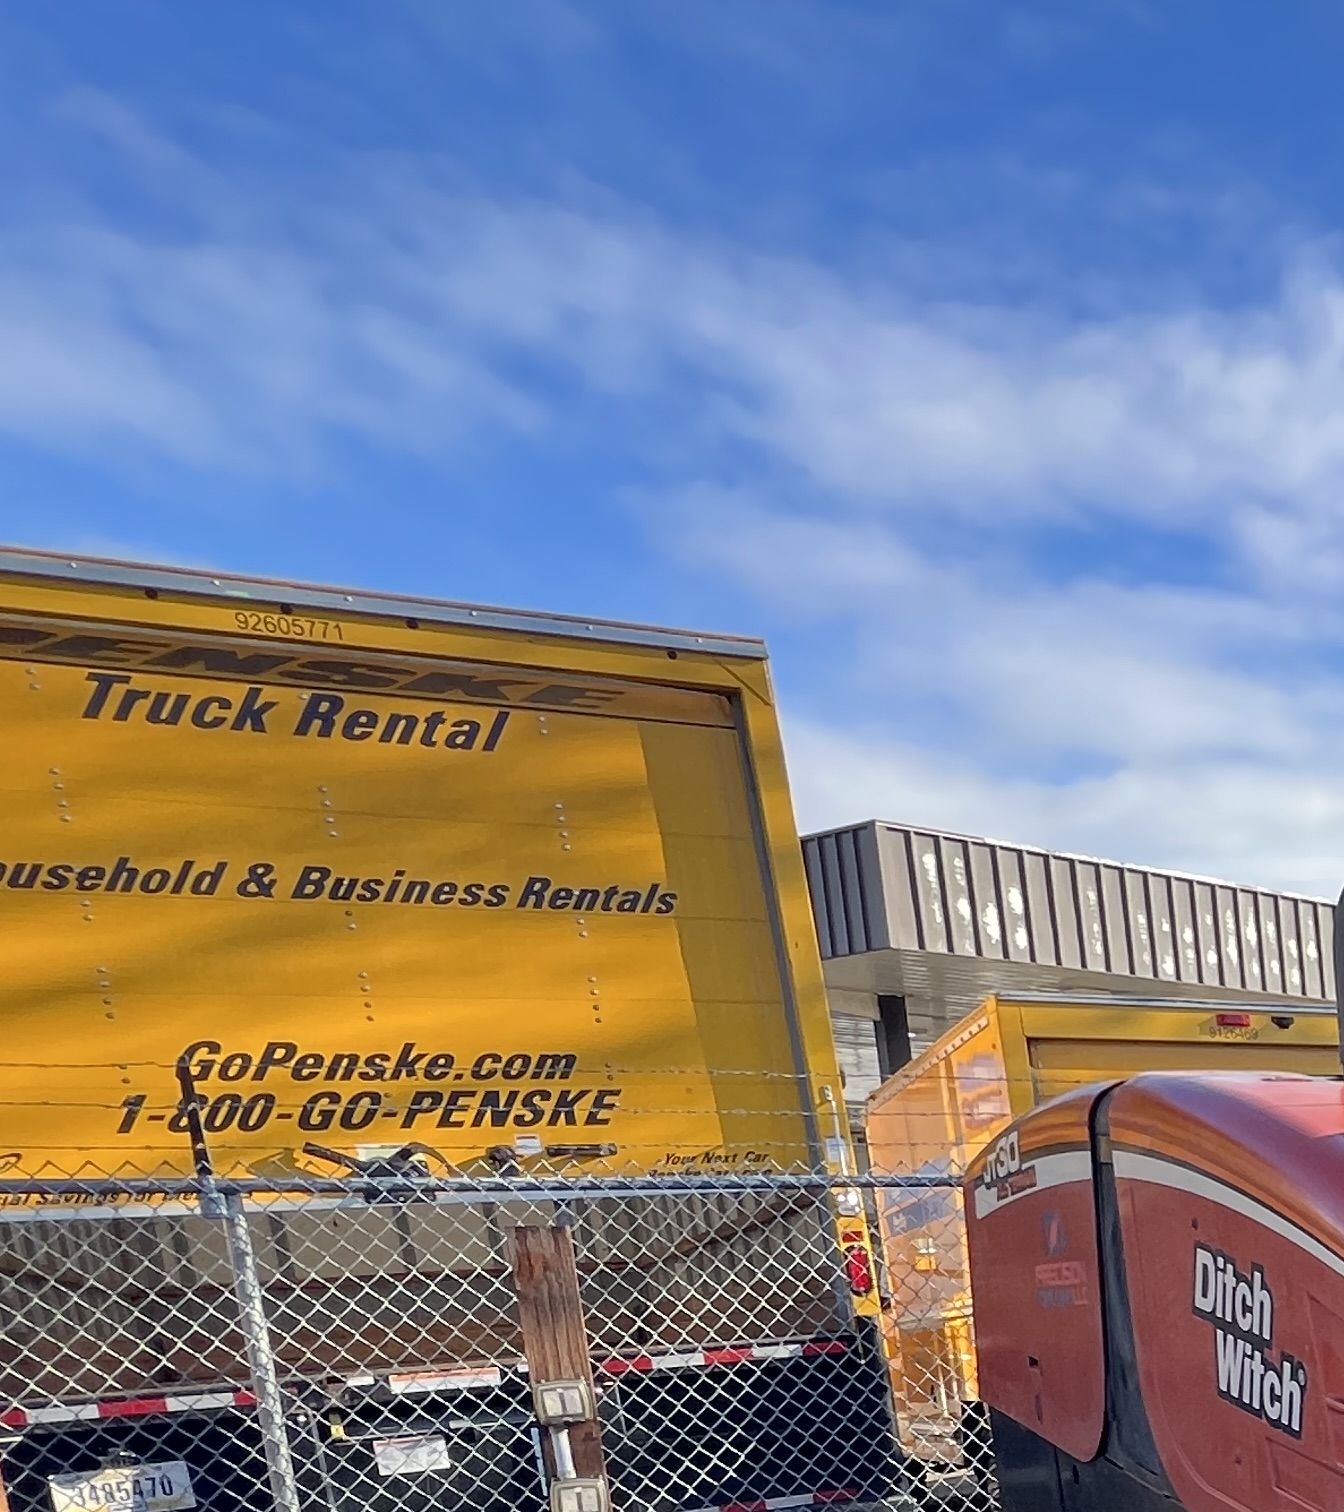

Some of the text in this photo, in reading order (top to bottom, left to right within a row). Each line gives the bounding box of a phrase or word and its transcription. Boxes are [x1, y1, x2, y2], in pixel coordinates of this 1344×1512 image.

[235, 612, 344, 641] 92605771
[82, 672, 510, 752] Truck Rental
[0, 857, 679, 914] usehold & Business Rentals
[181, 1040, 578, 1083] GoPenske.com
[116, 1088, 623, 1135] 1-800-GO-PENSKE
[744, 1151, 770, 1163] Car
[1194, 1247, 1272, 1341] Ditch
[1215, 1328, 1302, 1432] Witch
